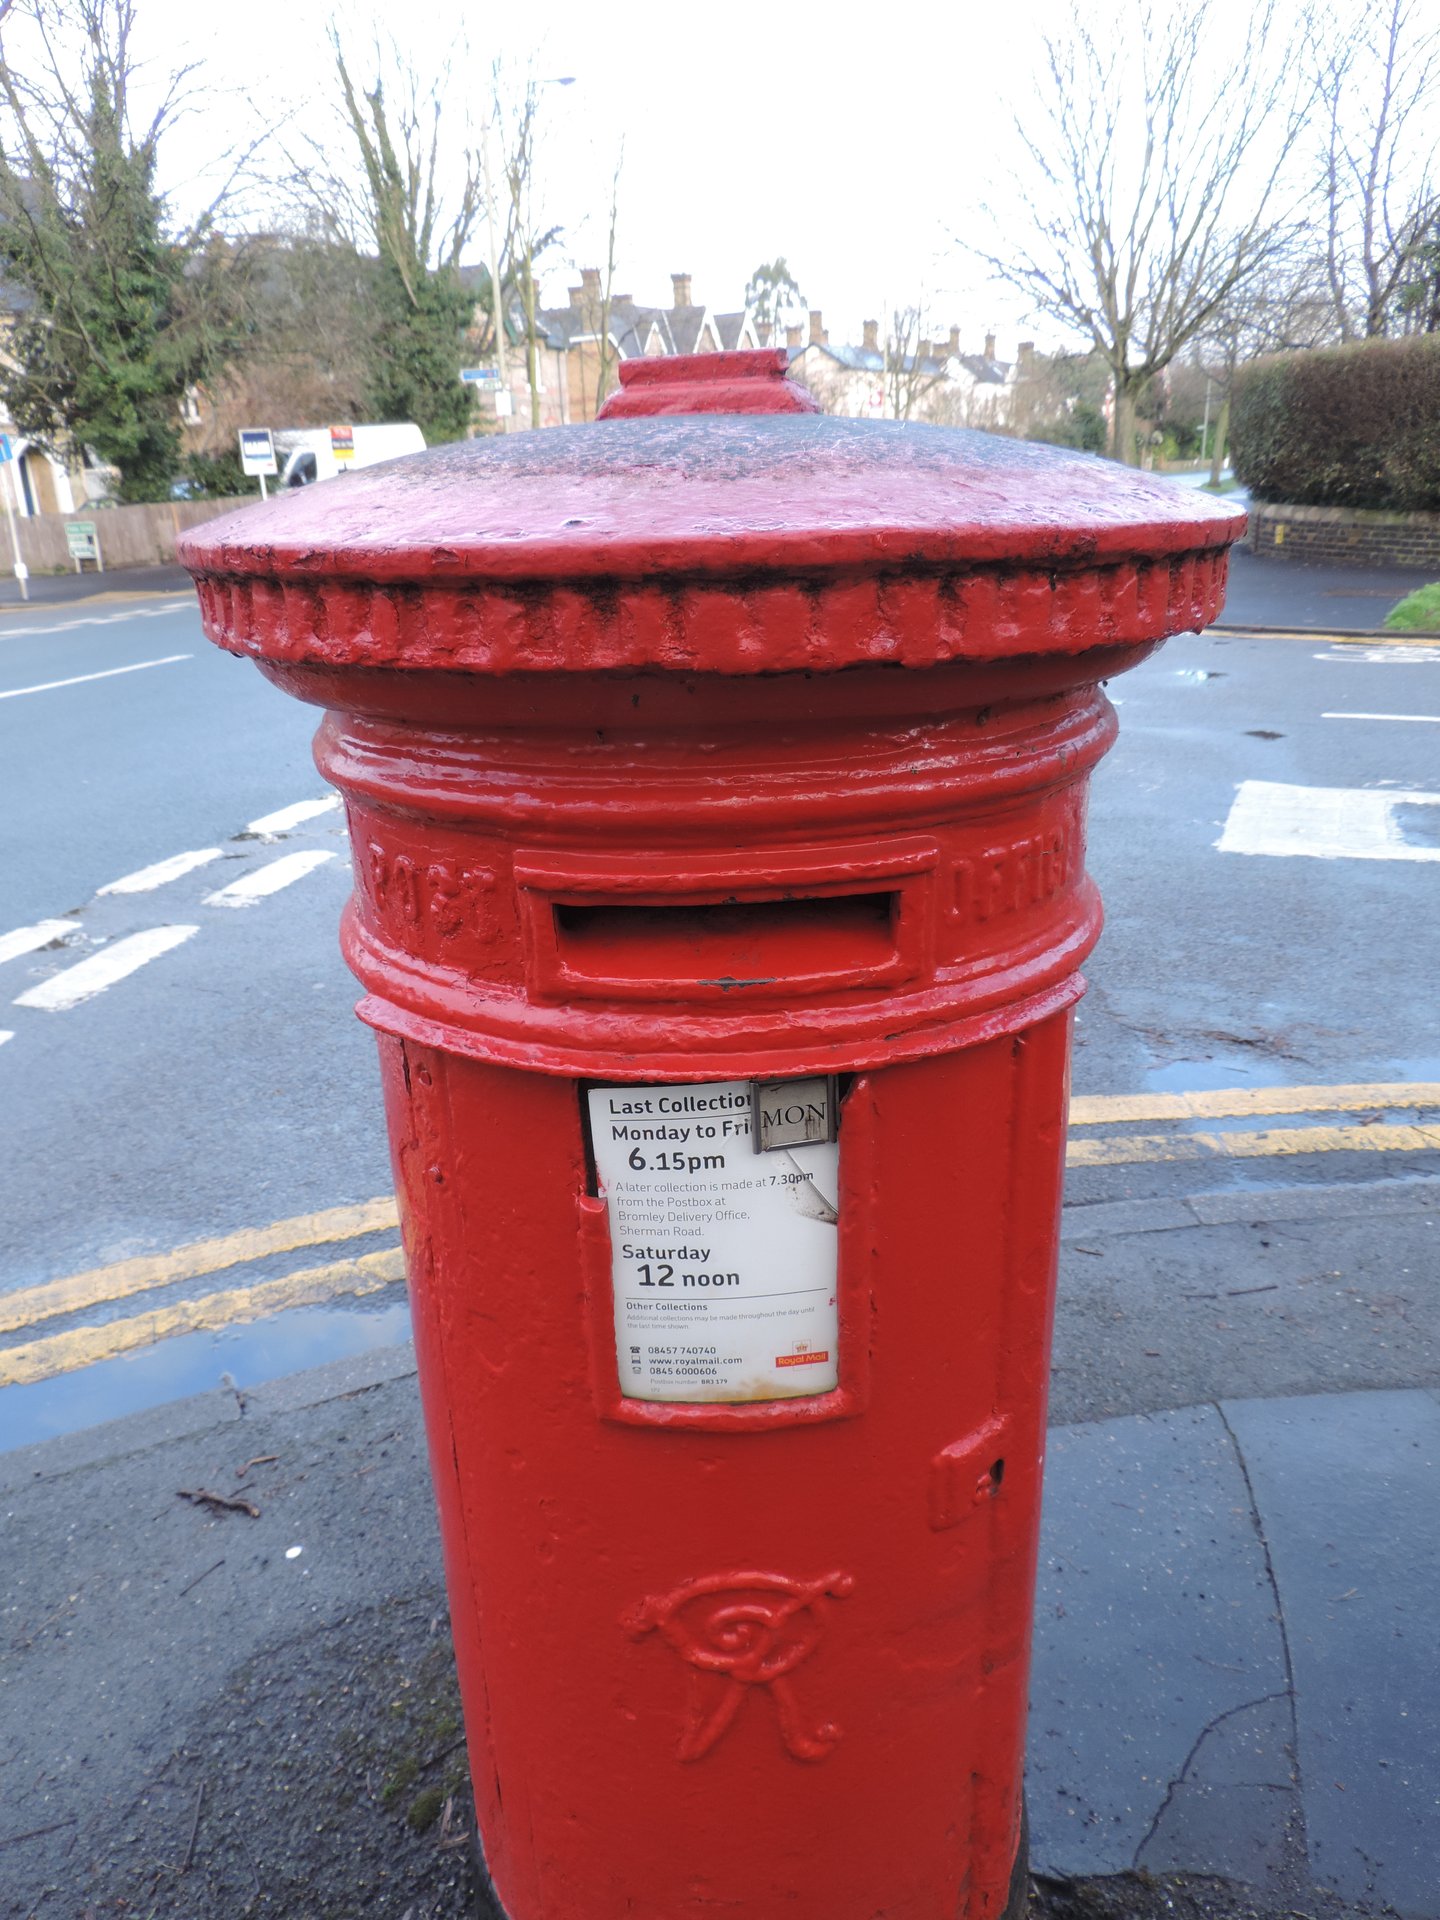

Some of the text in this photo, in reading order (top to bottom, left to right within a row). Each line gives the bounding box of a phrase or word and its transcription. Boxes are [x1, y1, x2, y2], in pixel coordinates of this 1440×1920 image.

[609, 1099, 654, 1115] Last
[761, 1101, 827, 1129] MON
[611, 1118, 752, 1143] Monday to Fri
[628, 1146, 726, 1174] 6.15pm
[615, 1172, 814, 1193] A later collection is made at 7.30pm
[616, 1196, 727, 1208] from the Postbox at
[618, 1210, 665, 1223] Bromley
[667, 1211, 713, 1224] Delivery
[619, 1225, 705, 1237] Sherman Road.
[622, 1244, 711, 1263] Saturday
[637, 1263, 740, 1287] 12 noon
[626, 1301, 709, 1312] Other Collections
[659, 1314, 694, 1322] collections
[694, 1315, 709, 1323] may
[709, 1313, 719, 1322] be
[719, 1312, 738, 1321] made
[738, 1311, 776, 1320] throughout
[787, 1308, 800, 1316] day
[800, 1306, 816, 1314] until
[647, 1346, 717, 1355] 08457 740740
[648, 1357, 743, 1367] www.royalmail.com
[778, 1352, 826, 1366] Royal Mail
[649, 1367, 718, 1376] 0845 6000606
